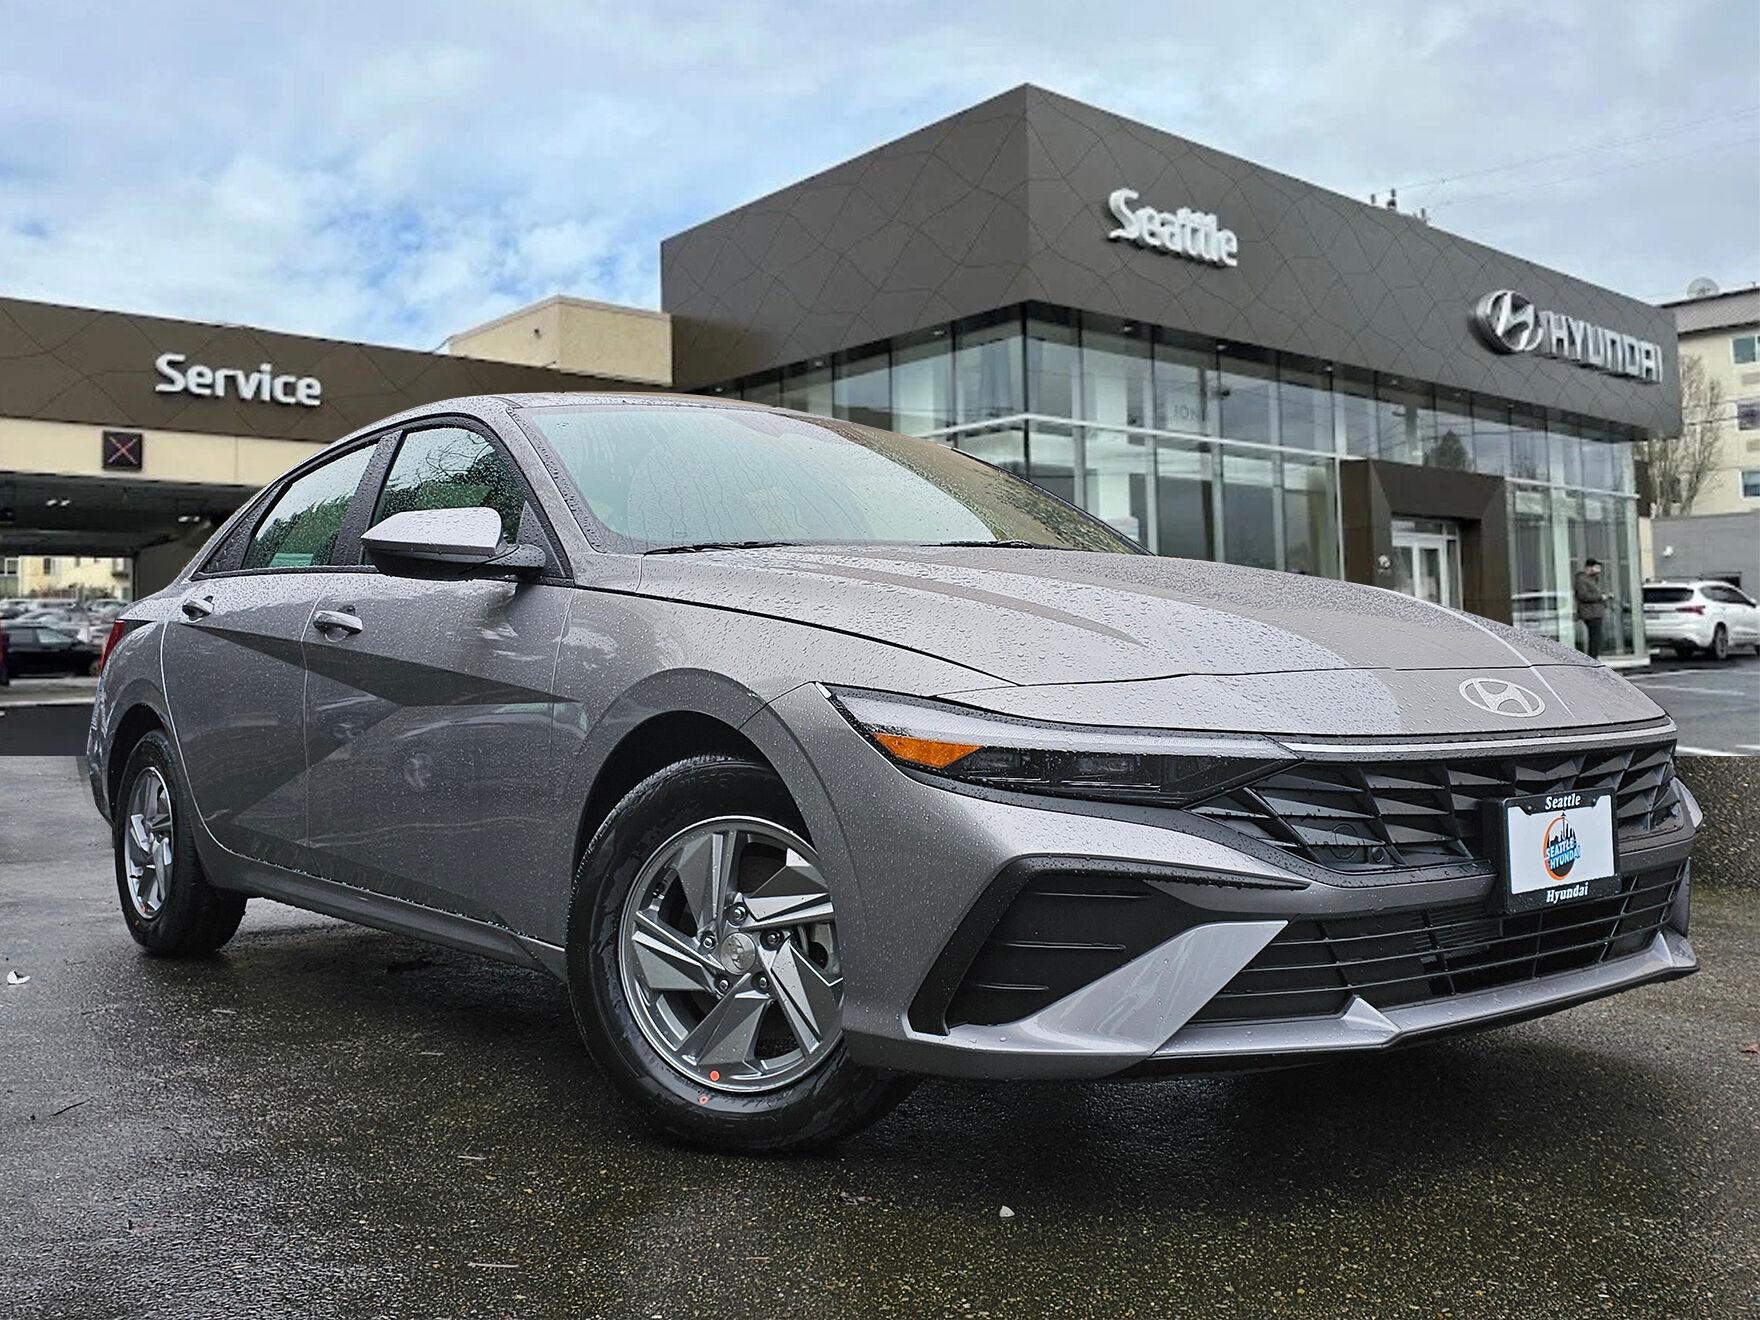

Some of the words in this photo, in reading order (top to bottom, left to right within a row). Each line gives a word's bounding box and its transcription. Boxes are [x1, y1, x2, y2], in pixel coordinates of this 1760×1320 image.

[1108, 188, 1238, 267] Seattle
[1540, 311, 1663, 382] HYUNDAI
[155, 352, 322, 406] Service
[1545, 793, 1581, 810] Seattle
[1546, 882, 1589, 904] Hyundai
